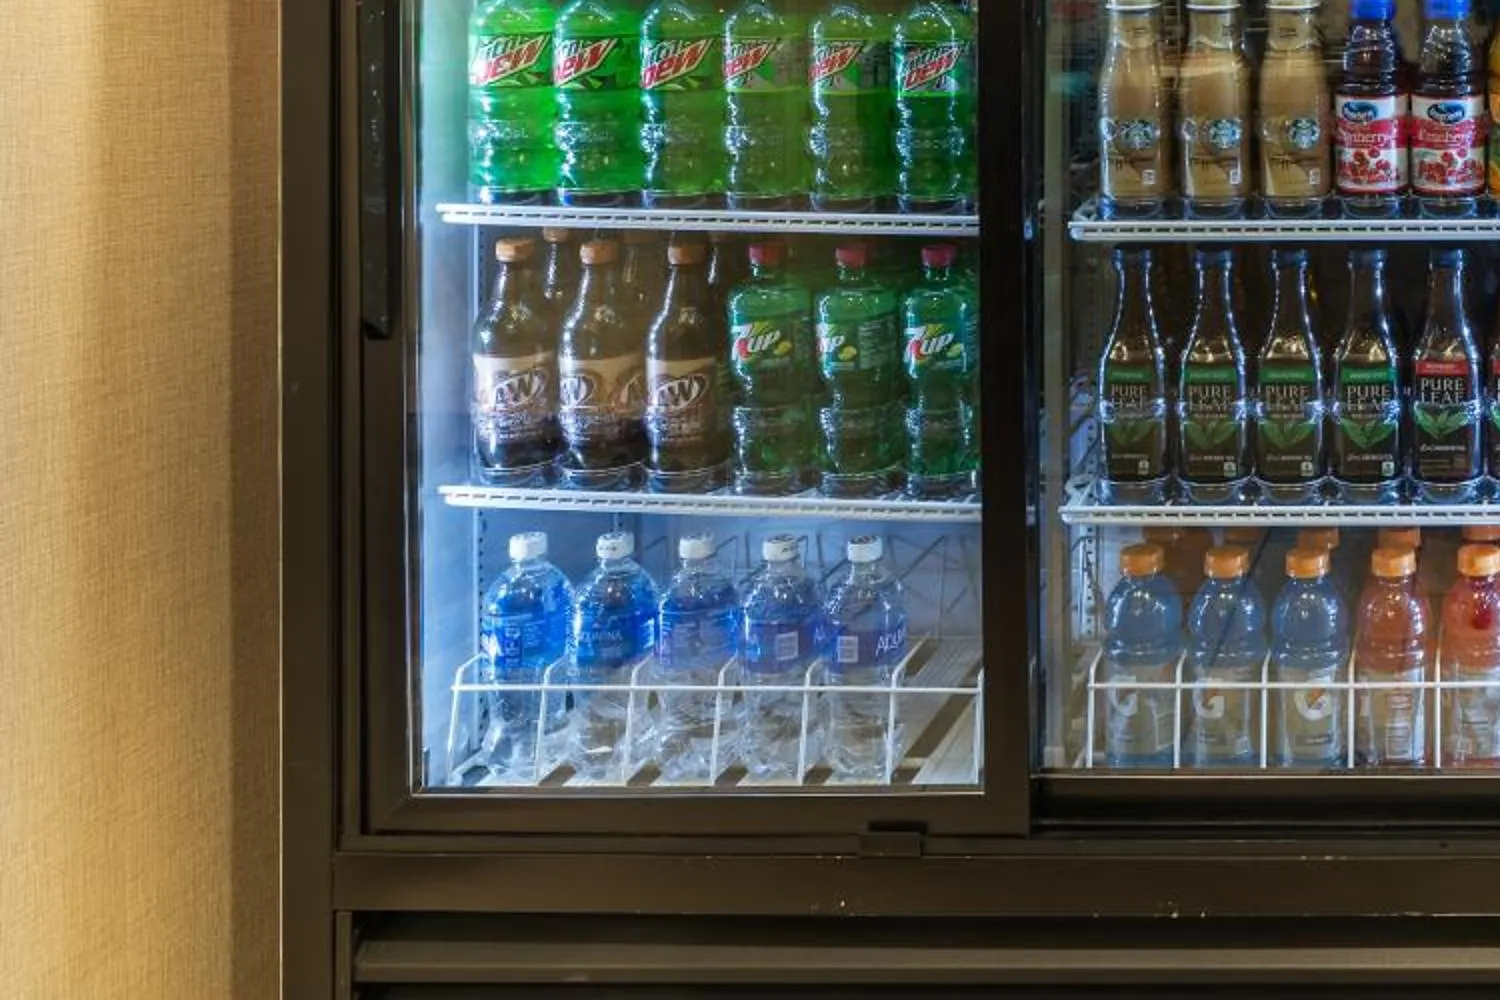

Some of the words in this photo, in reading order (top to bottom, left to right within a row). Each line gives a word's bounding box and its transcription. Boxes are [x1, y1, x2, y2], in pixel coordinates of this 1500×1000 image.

[1110, 384, 1148, 399] PURE
[1347, 385, 1391, 398] PURE
[1421, 378, 1465, 391] PURE
[1188, 385, 1232, 399] PURE
[1265, 385, 1310, 399] PURE
